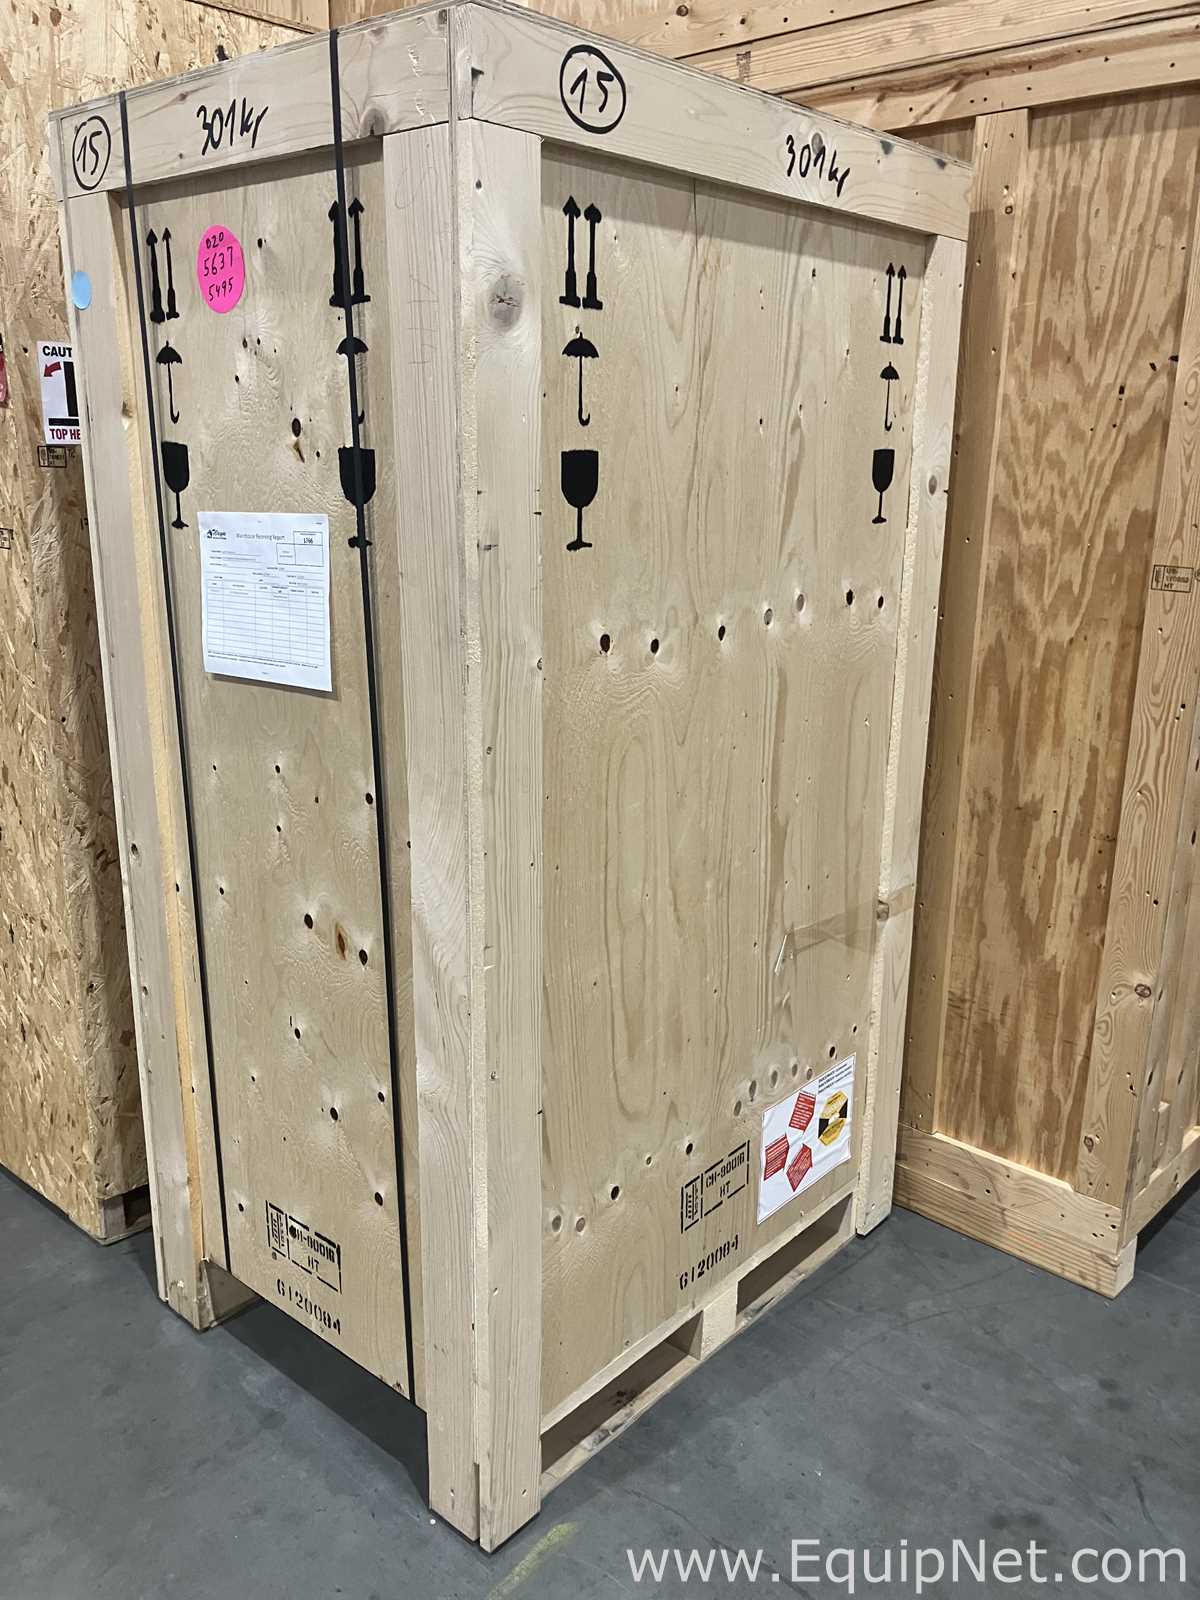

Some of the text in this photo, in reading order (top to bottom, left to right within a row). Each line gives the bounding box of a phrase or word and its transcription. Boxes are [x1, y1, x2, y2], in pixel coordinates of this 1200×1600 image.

[570, 68, 615, 113] 15
[76, 130, 103, 175] 15
[203, 246, 234, 277] 5637
[208, 276, 235, 302] 5495
[49, 428, 69, 440] TOP
